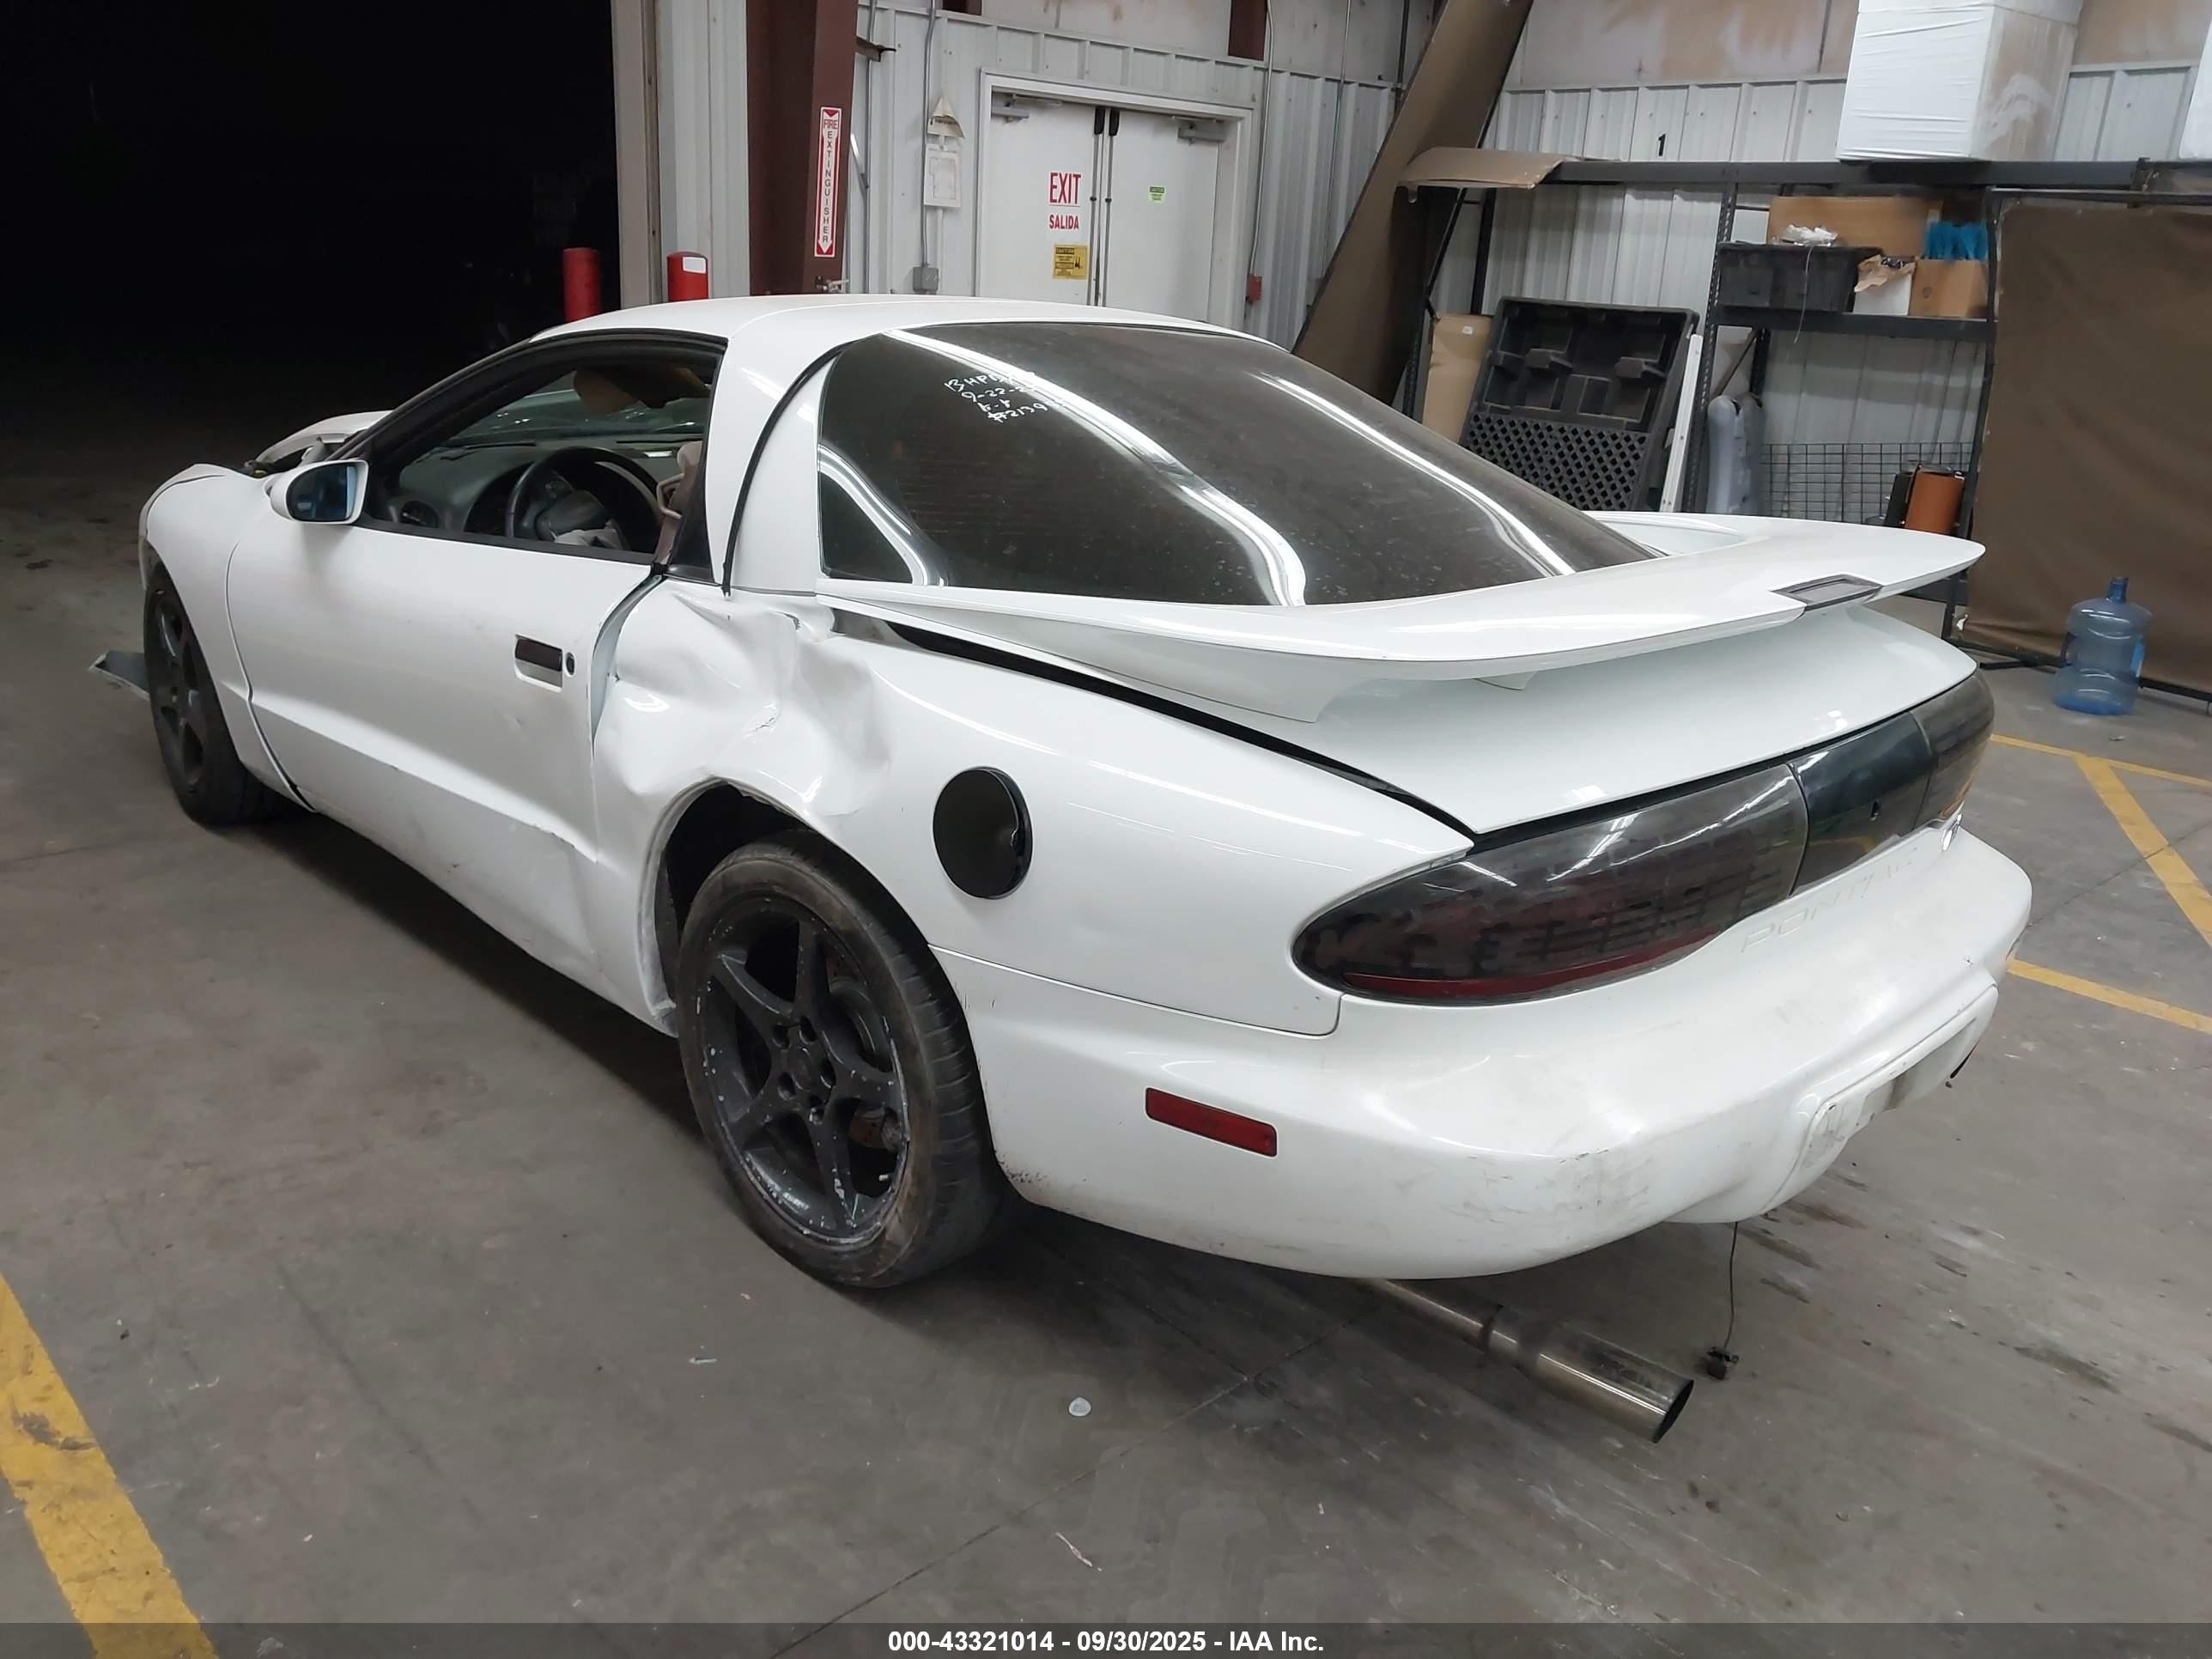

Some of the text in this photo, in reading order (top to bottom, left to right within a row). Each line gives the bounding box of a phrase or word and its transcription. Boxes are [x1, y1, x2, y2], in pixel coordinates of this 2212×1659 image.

[823, 118, 838, 129] FIRE
[1658, 133, 1666, 157] 1
[822, 131, 833, 243] EXTINGUISHER
[1049, 172, 1082, 204] EXIT
[1049, 214, 1079, 230] SALIDA
[961, 386, 1034, 402] 9-22-2
